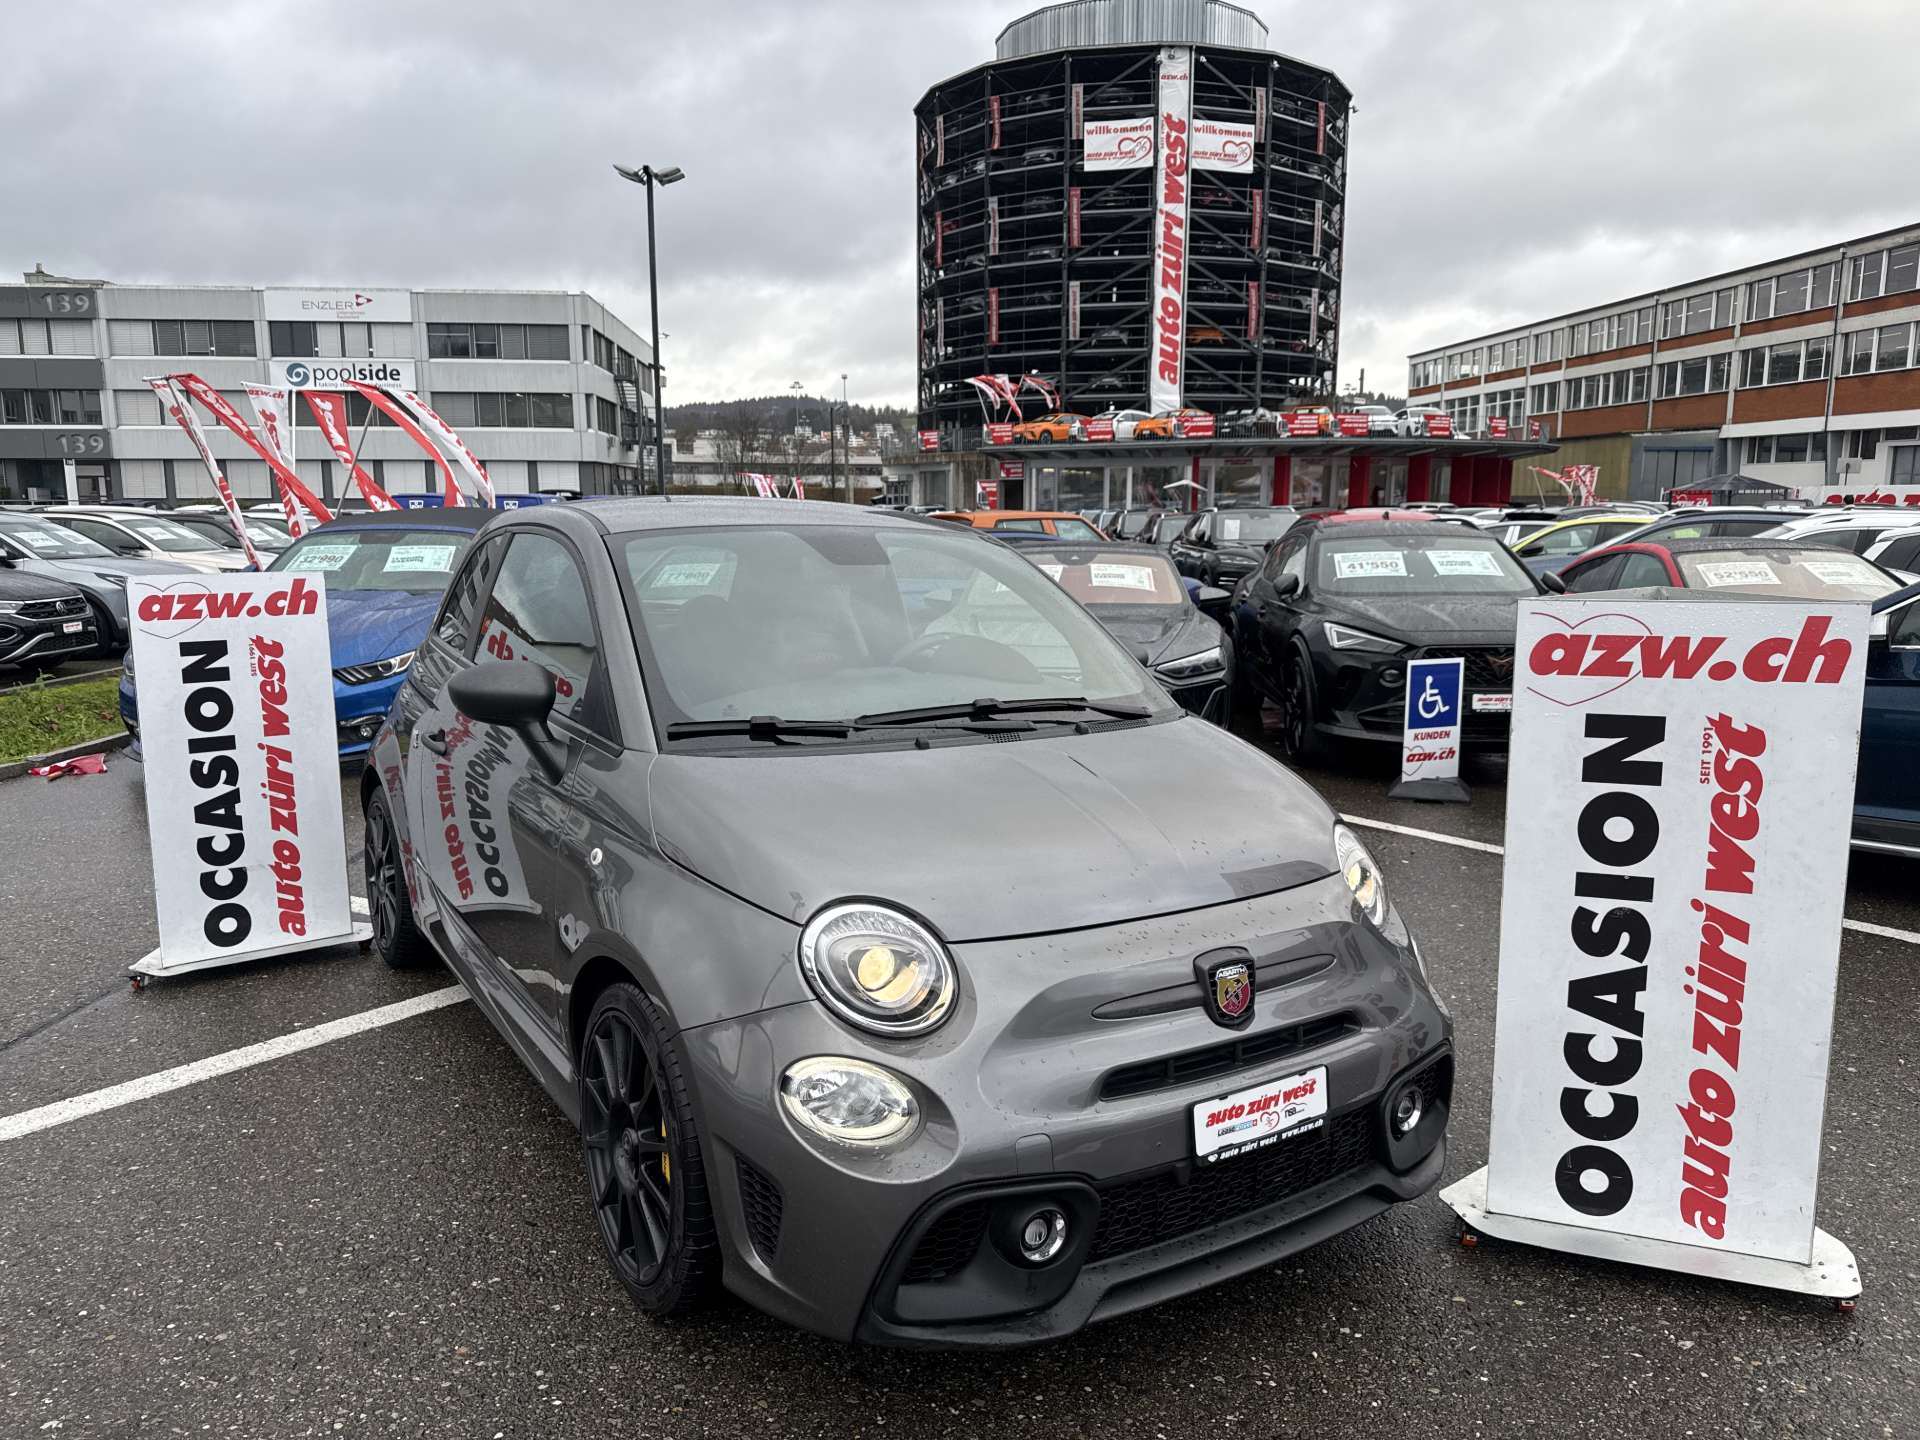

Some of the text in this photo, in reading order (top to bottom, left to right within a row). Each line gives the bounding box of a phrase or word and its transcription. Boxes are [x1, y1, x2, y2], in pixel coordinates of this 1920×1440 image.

[1086, 124, 1152, 136] willkommen
[1193, 125, 1254, 138] willkommen
[1156, 112, 1187, 386] auto züri west
[40, 292, 90, 313] 139
[301, 300, 353, 311] ENZLER
[313, 363, 401, 388] poolside
[55, 433, 104, 454] 139
[138, 578, 319, 622] azw.ch
[1528, 615, 1853, 684] azw.ch
[1413, 729, 1452, 742] KUNDEN
[1405, 747, 1457, 763] azw.ch
[1699, 726, 1714, 785] SEIT 1991
[179, 639, 252, 948] OCCASION
[248, 634, 307, 937] auto züri west
[1554, 713, 1668, 1217] OCCASION
[1676, 711, 1768, 1241] auto züri west
[1206, 1078, 1317, 1129] auto züri west
[1219, 1148, 1239, 1160] auto
[1259, 1134, 1279, 1148] west
